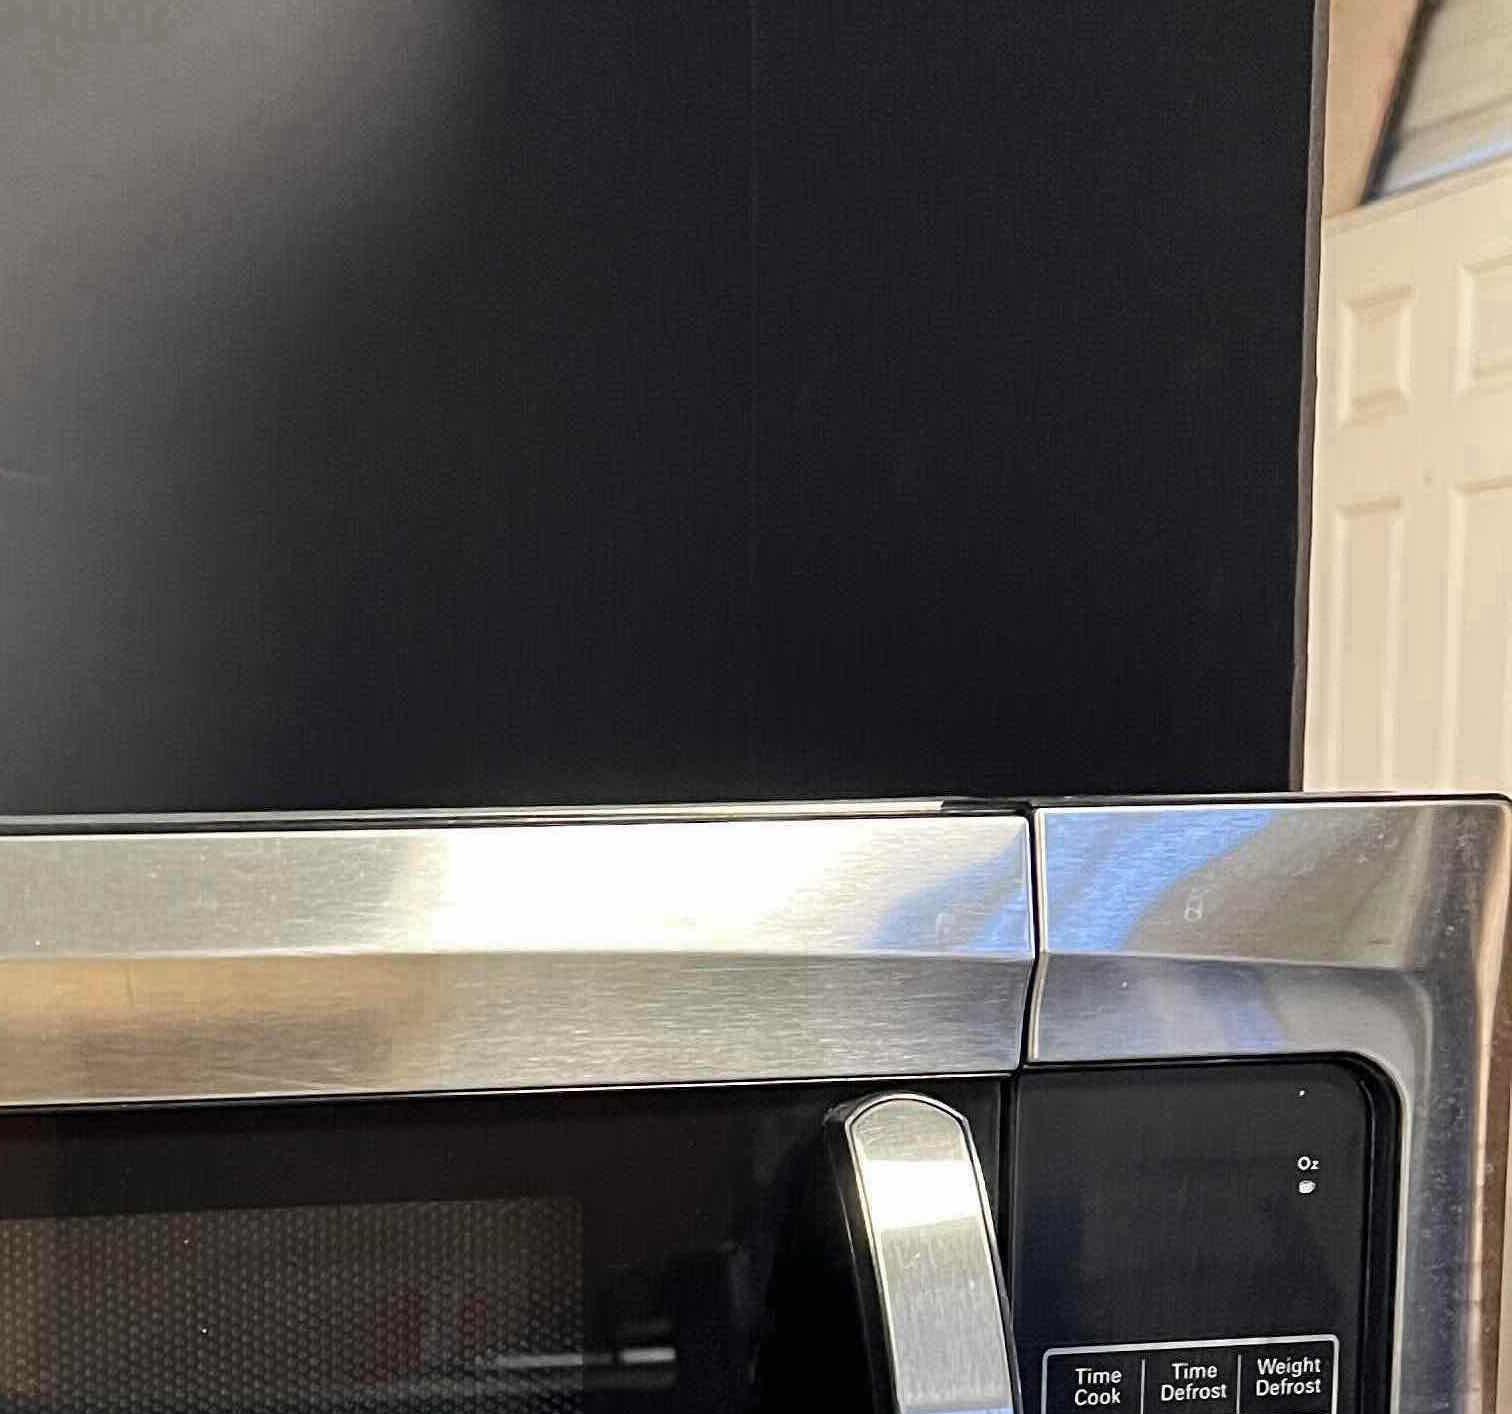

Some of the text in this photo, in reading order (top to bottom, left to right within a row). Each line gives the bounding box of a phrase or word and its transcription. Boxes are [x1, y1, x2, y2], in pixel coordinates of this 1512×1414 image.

[1076, 1368, 1122, 1384] Time
[1172, 1363, 1217, 1380] Time
[1257, 1358, 1321, 1378] Weight
[1161, 1383, 1226, 1401] Defrost
[1256, 1379, 1321, 1396] Defrost
[1074, 1390, 1120, 1406] Cook
